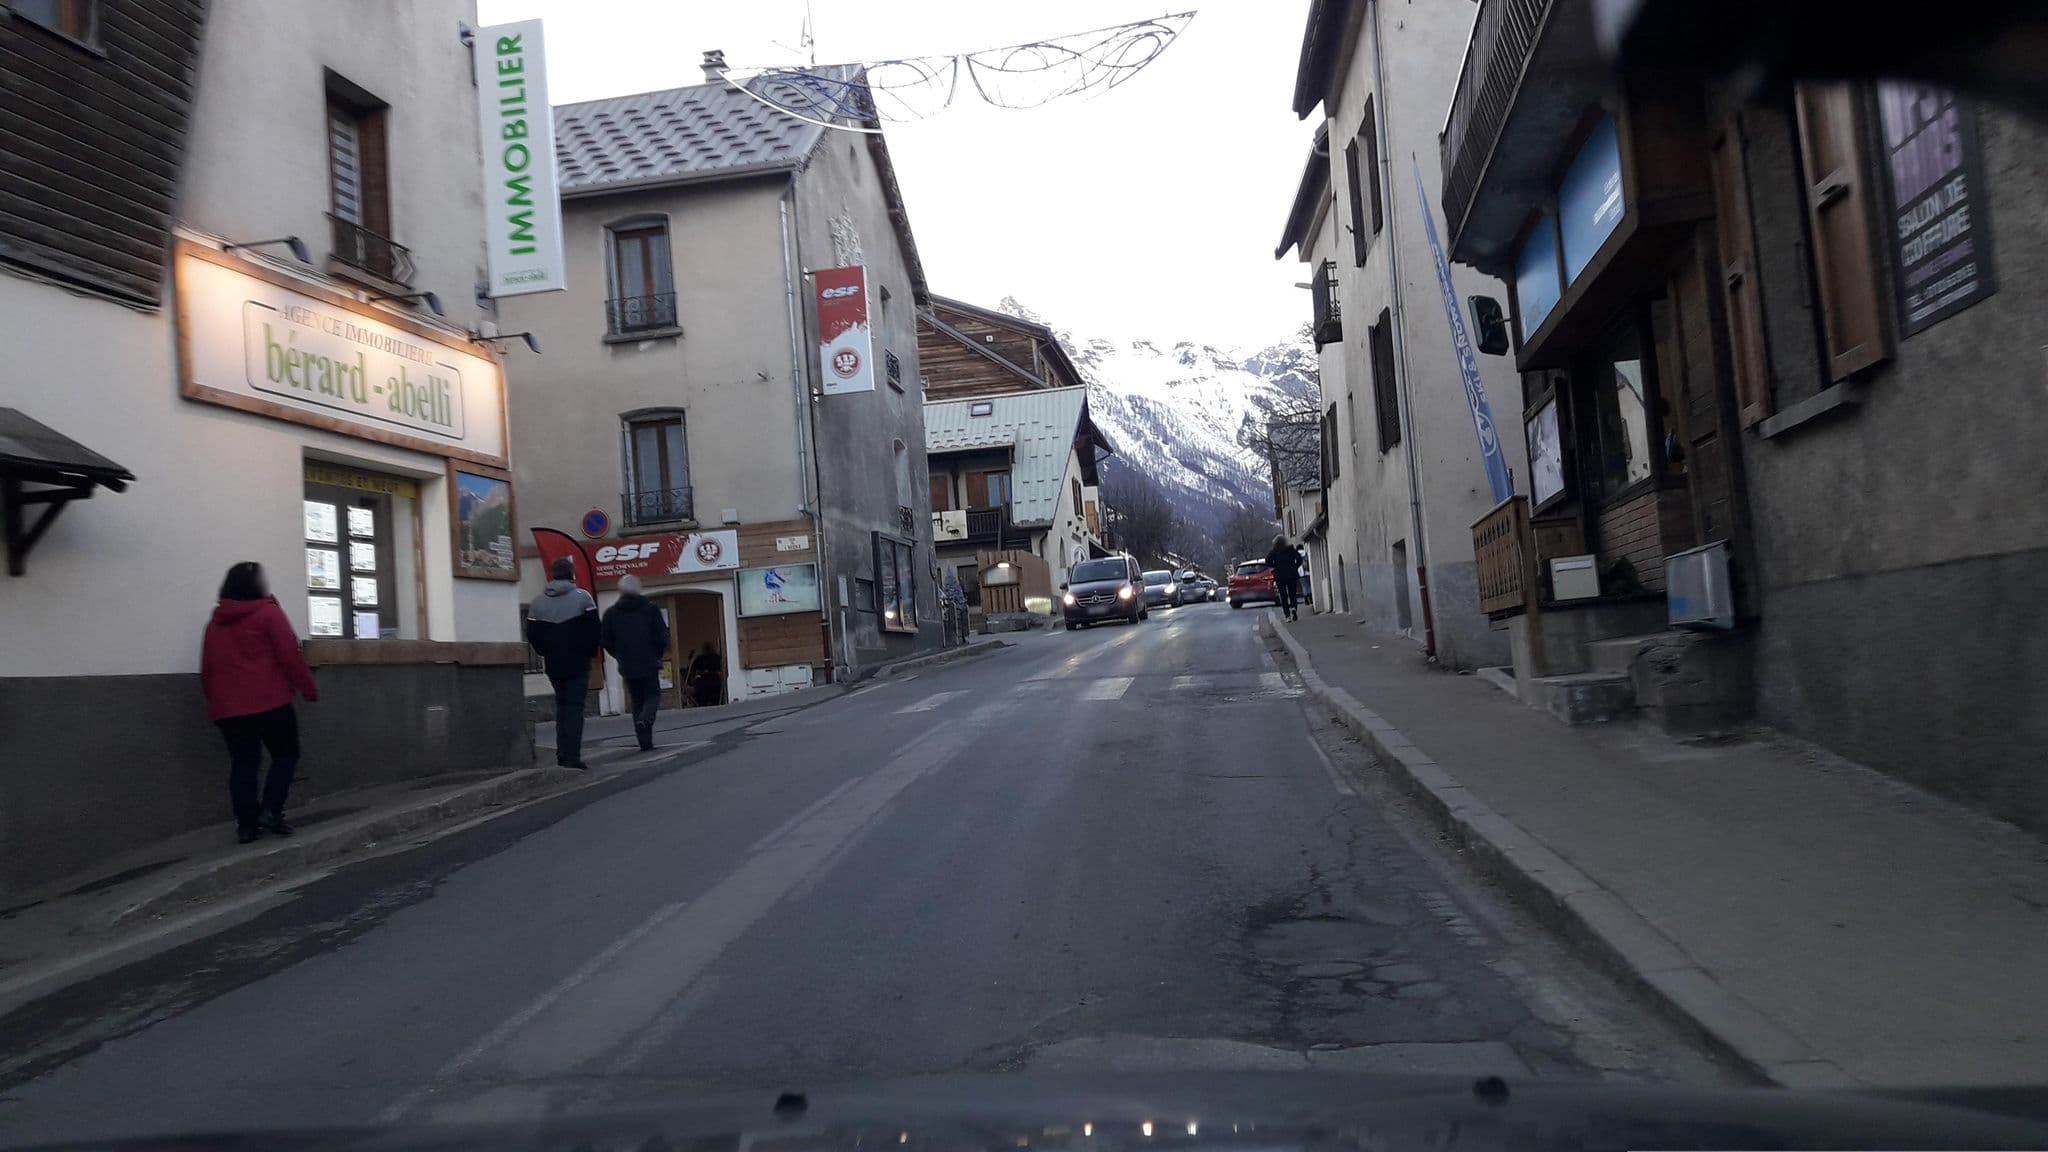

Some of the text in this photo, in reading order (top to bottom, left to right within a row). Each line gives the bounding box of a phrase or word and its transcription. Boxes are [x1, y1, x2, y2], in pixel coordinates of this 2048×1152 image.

[496, 32, 537, 256] IMMOBILIER
[280, 304, 433, 367] AGENCE IMMOBILIERE
[387, 365, 453, 428] abelli
[616, 562, 648, 570] CHEVALIER
